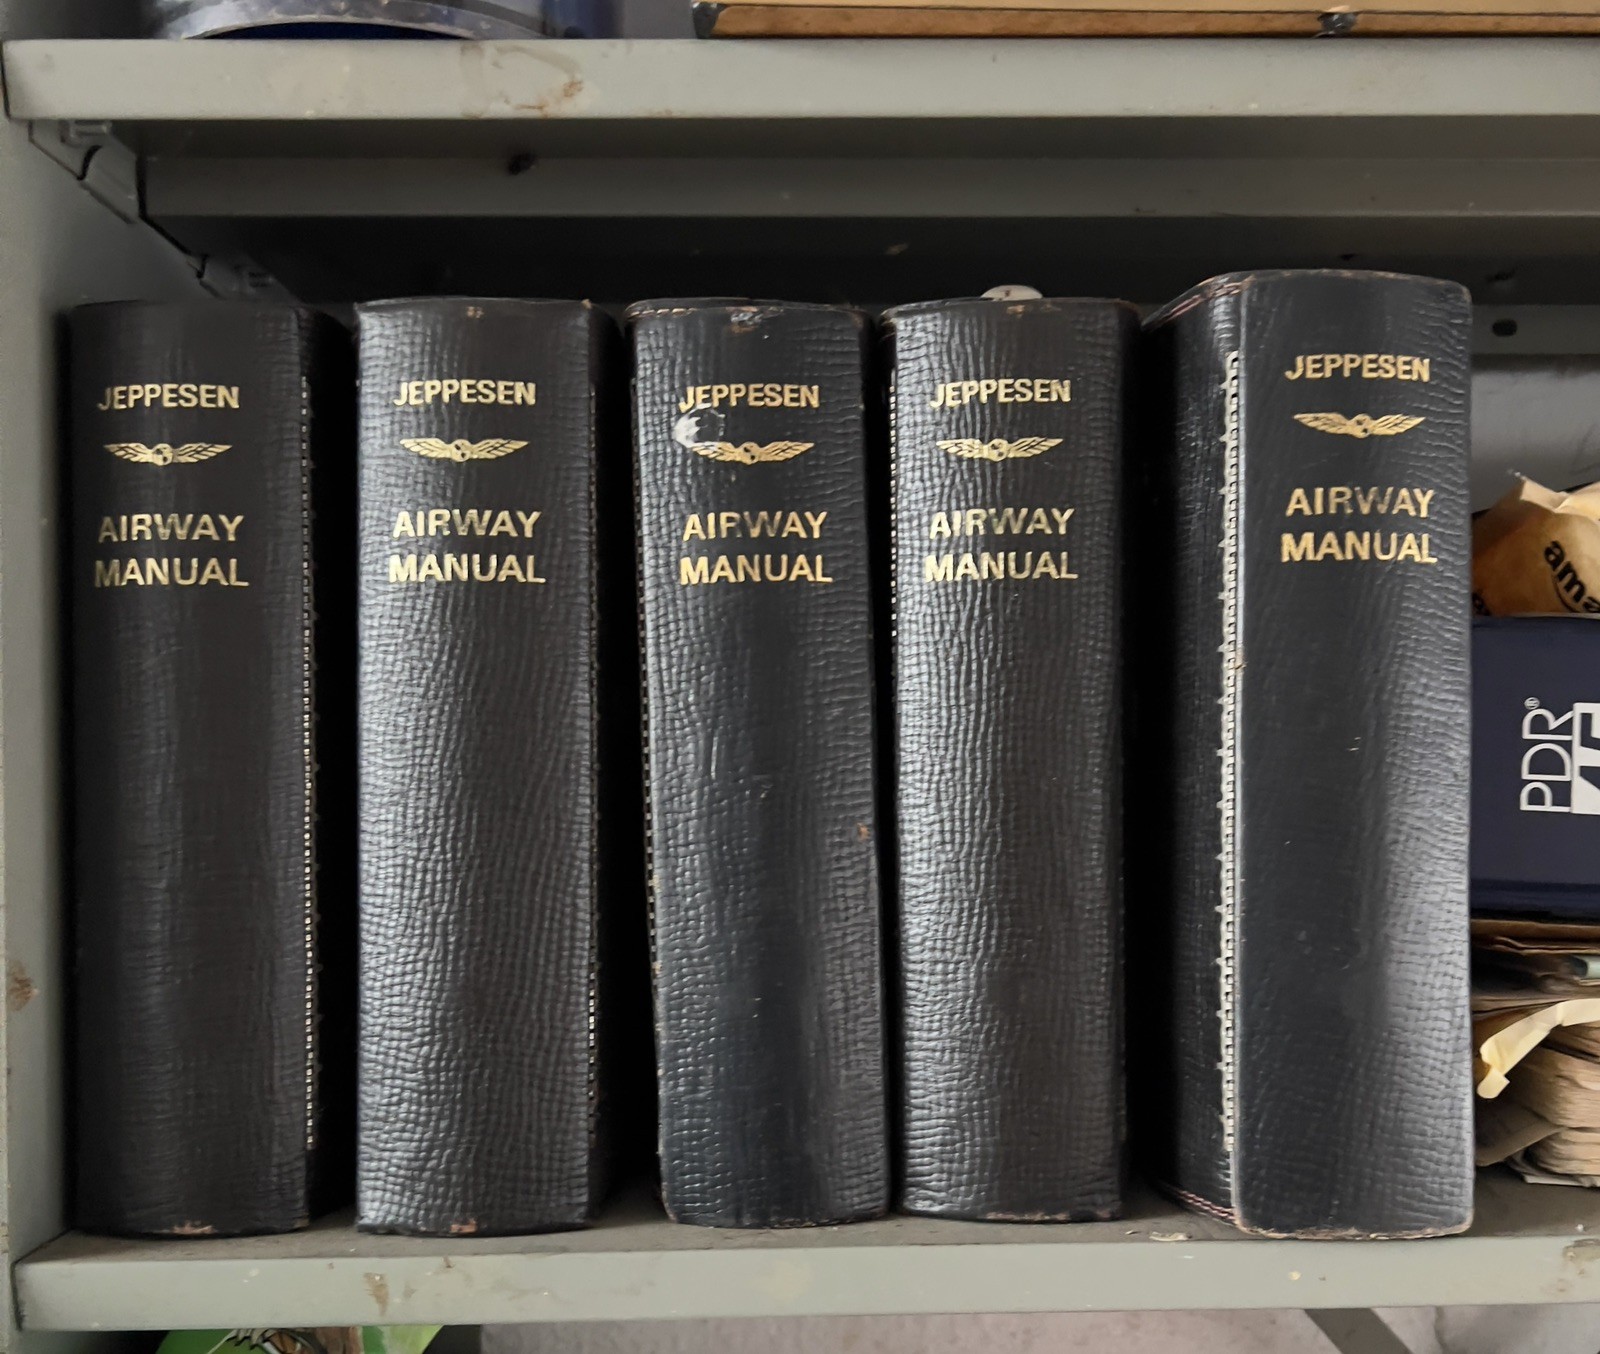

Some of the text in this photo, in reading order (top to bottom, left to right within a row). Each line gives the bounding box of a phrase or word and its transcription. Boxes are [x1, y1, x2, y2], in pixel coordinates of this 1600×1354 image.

[1285, 354, 1430, 382] JEPPESEN
[97, 383, 240, 411] JEPPESEN
[393, 379, 536, 406] JEPPESEN
[678, 383, 820, 413] JEPPESEN
[930, 379, 1071, 409] JEPPESEN
[1285, 486, 1434, 518] AIRWAY
[98, 514, 244, 543] AIRWAY
[392, 509, 542, 538] AIRWAY
[682, 511, 827, 541] AIRWAY
[930, 508, 1075, 539] AIRWAY
[1281, 530, 1437, 563] MANUAL
[95, 557, 249, 587] MANUAL
[389, 554, 546, 583] MANUAL
[680, 554, 833, 585] MANUAL
[924, 551, 1078, 583] MANUAL
